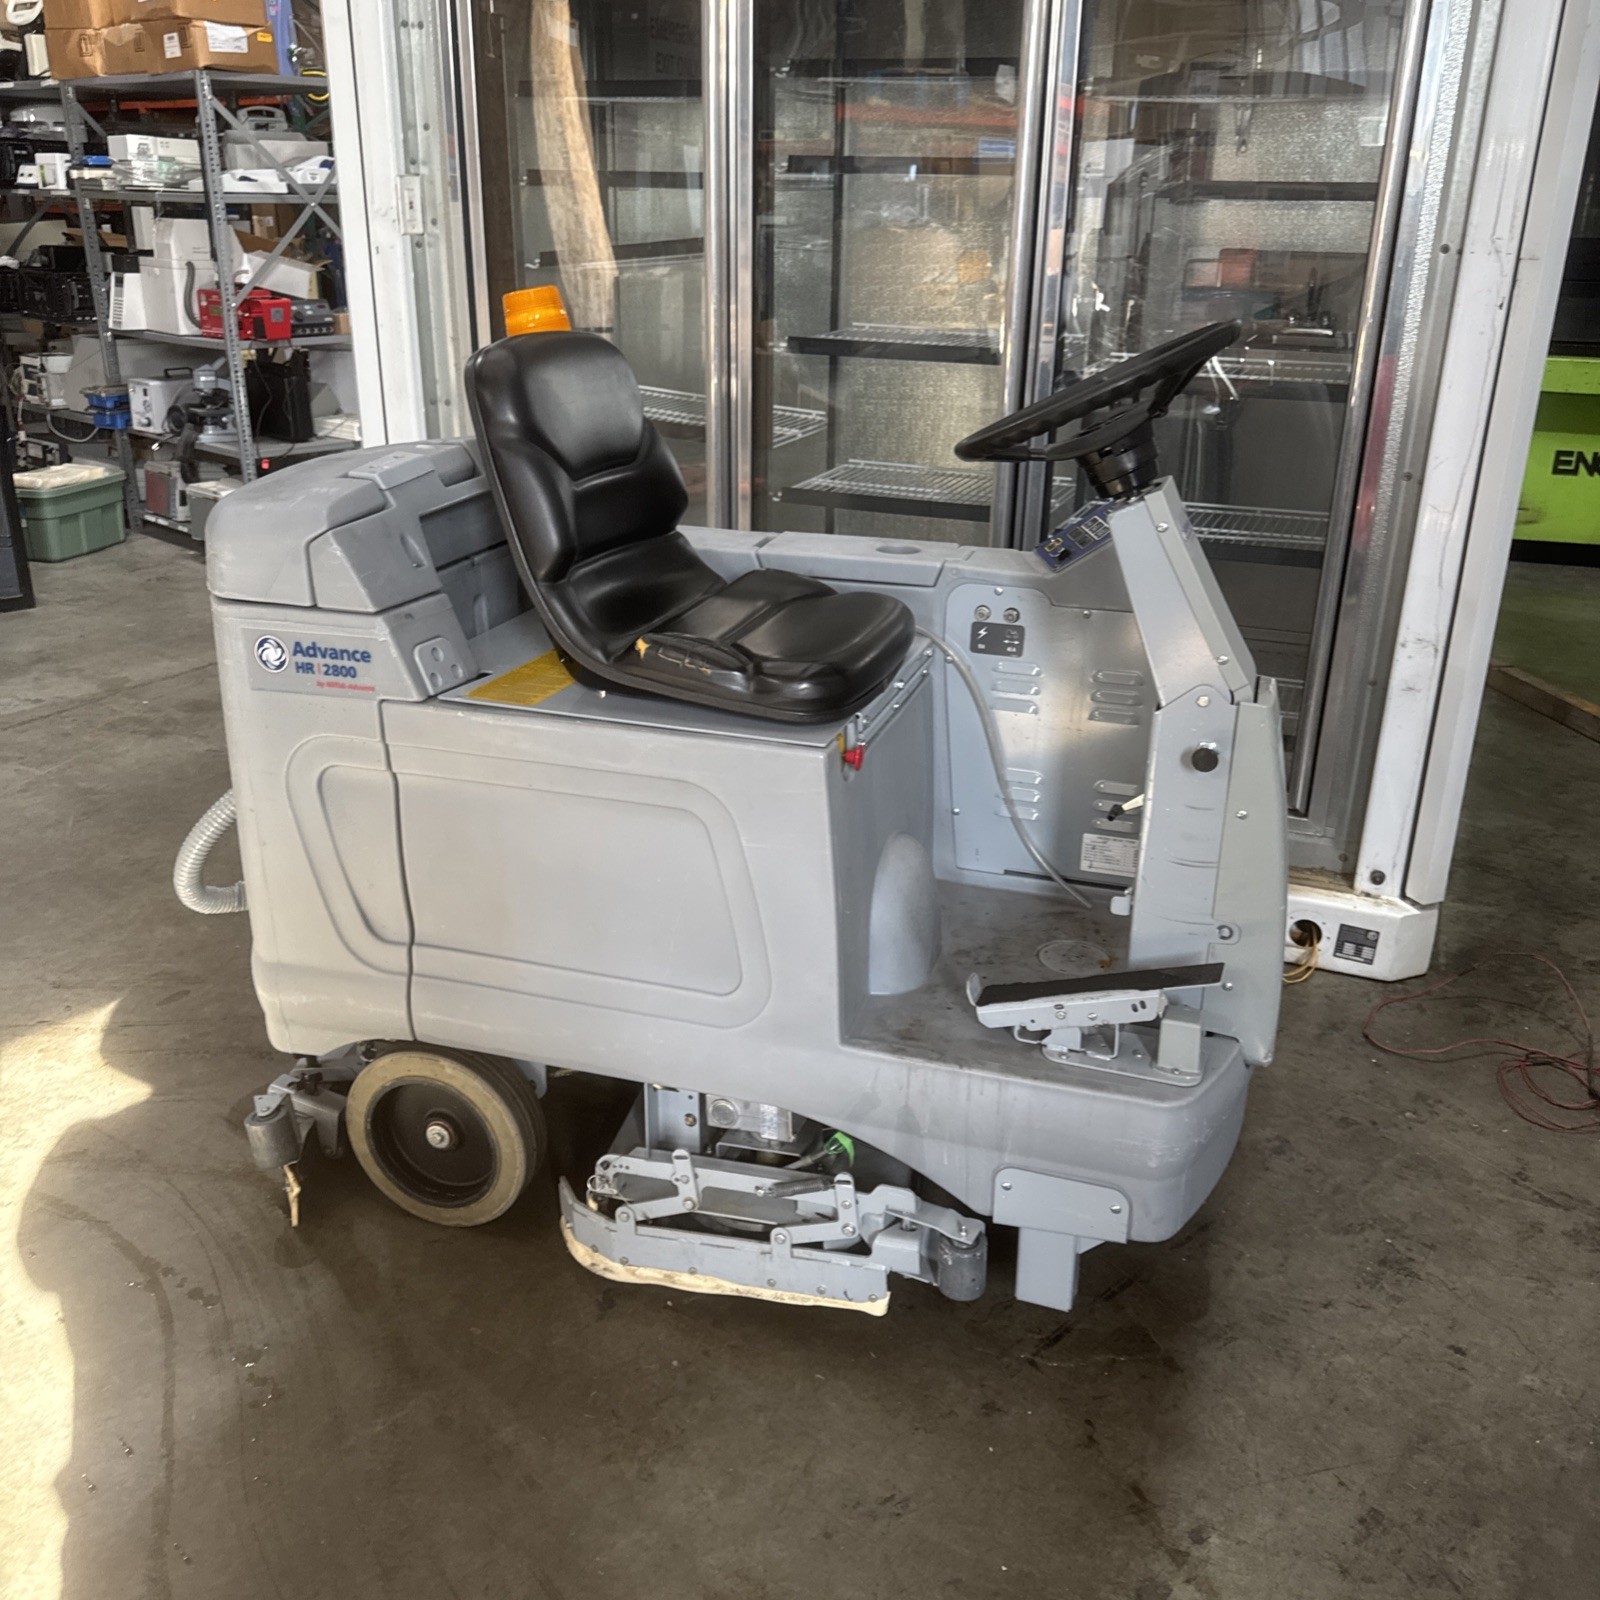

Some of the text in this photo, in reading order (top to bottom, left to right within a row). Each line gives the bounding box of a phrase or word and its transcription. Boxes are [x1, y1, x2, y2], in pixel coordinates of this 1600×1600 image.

[1551, 450, 1600, 477] EN
[292, 641, 372, 663] Advance
[295, 662, 357, 678] HR 2800
